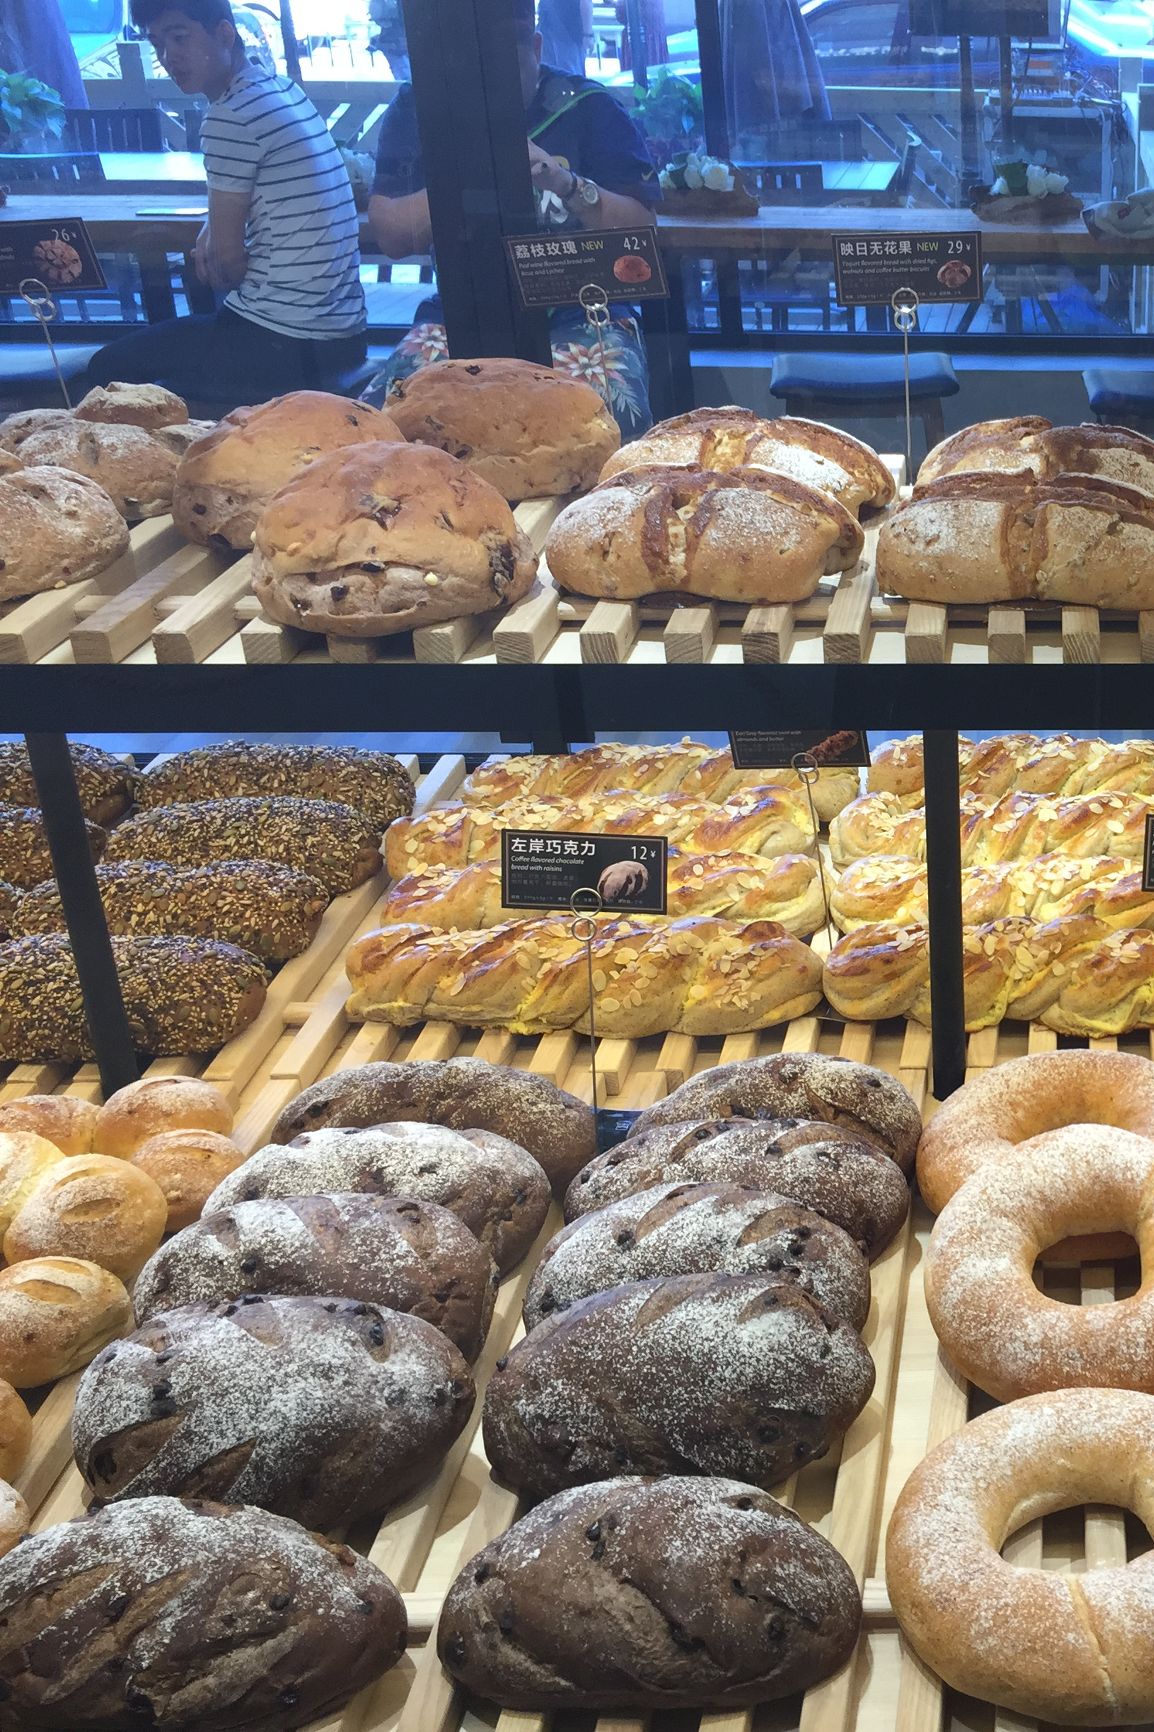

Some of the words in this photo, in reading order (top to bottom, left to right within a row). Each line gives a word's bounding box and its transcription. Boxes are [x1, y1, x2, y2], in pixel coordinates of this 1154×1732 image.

[514, 240, 578, 259] 荔枝玫瑰
[581, 240, 604, 251] NEW
[840, 240, 912, 256] 映日无花果
[916, 242, 939, 251] NEW
[511, 837, 596, 857] 左岸巧克力
[511, 855, 530, 863] Coffee
[530, 856, 555, 864] flavored
[555, 857, 584, 865] chocolate
